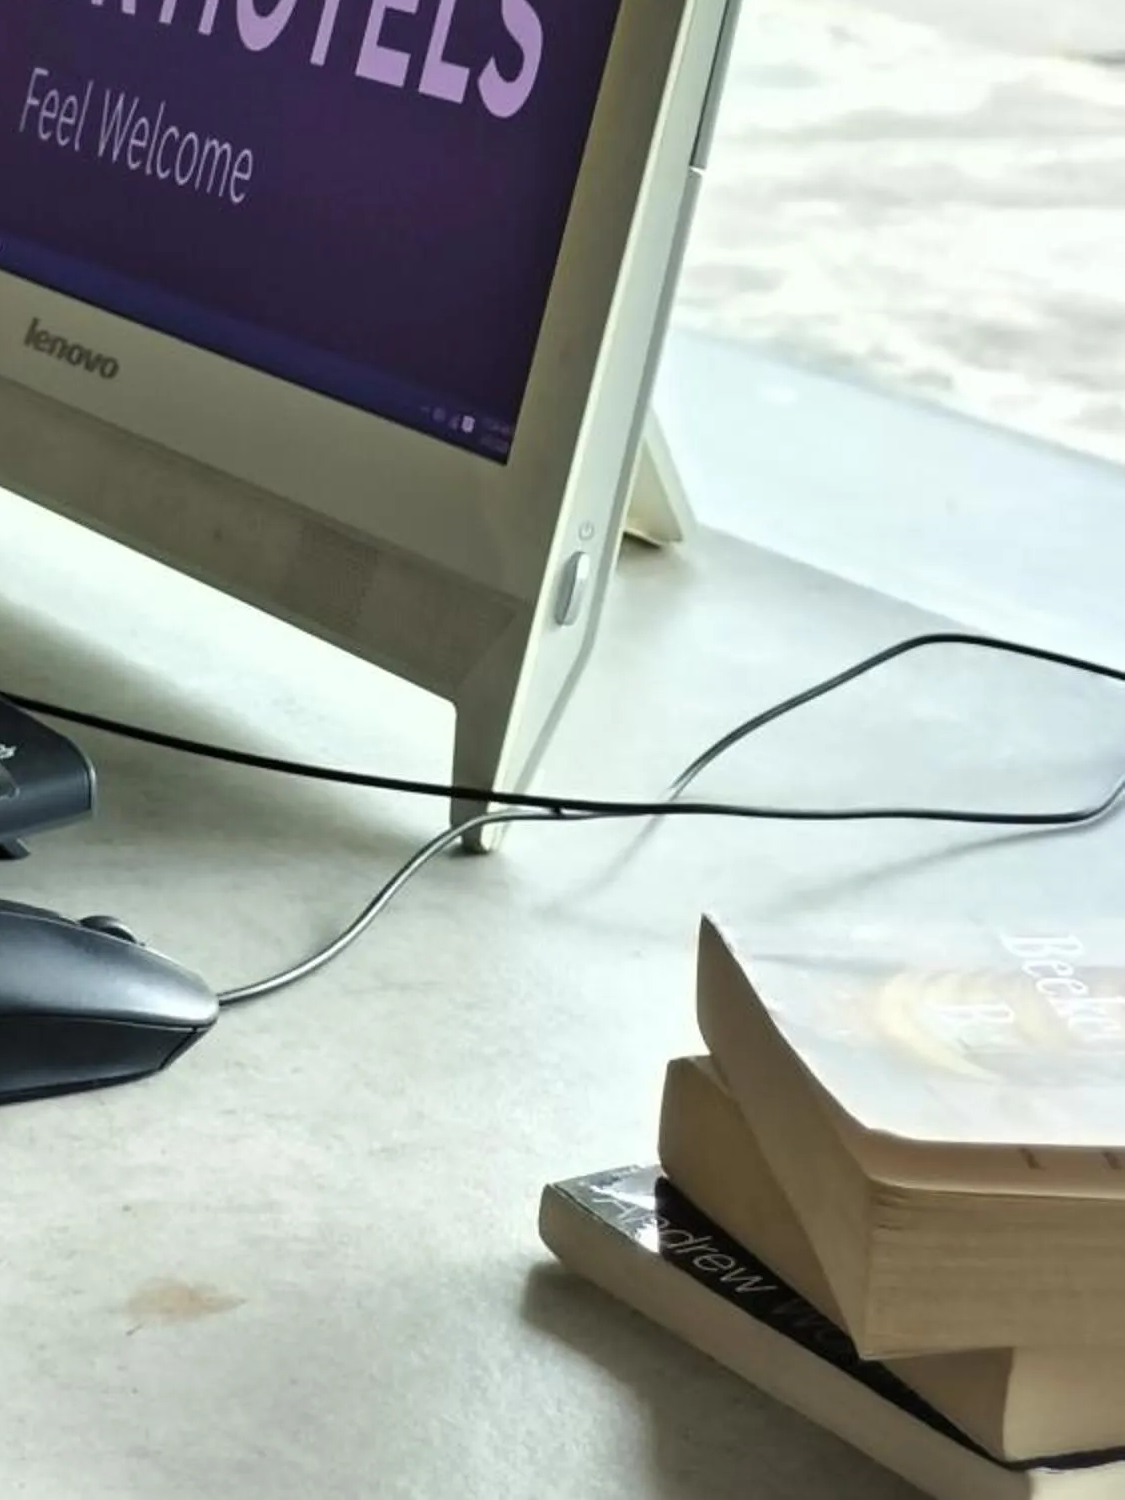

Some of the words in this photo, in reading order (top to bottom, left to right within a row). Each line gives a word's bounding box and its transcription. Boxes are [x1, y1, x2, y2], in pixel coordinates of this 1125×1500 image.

[19, 67, 94, 151] Feel
[97, 89, 254, 205] Welcome
[23, 316, 120, 380] lenovo
